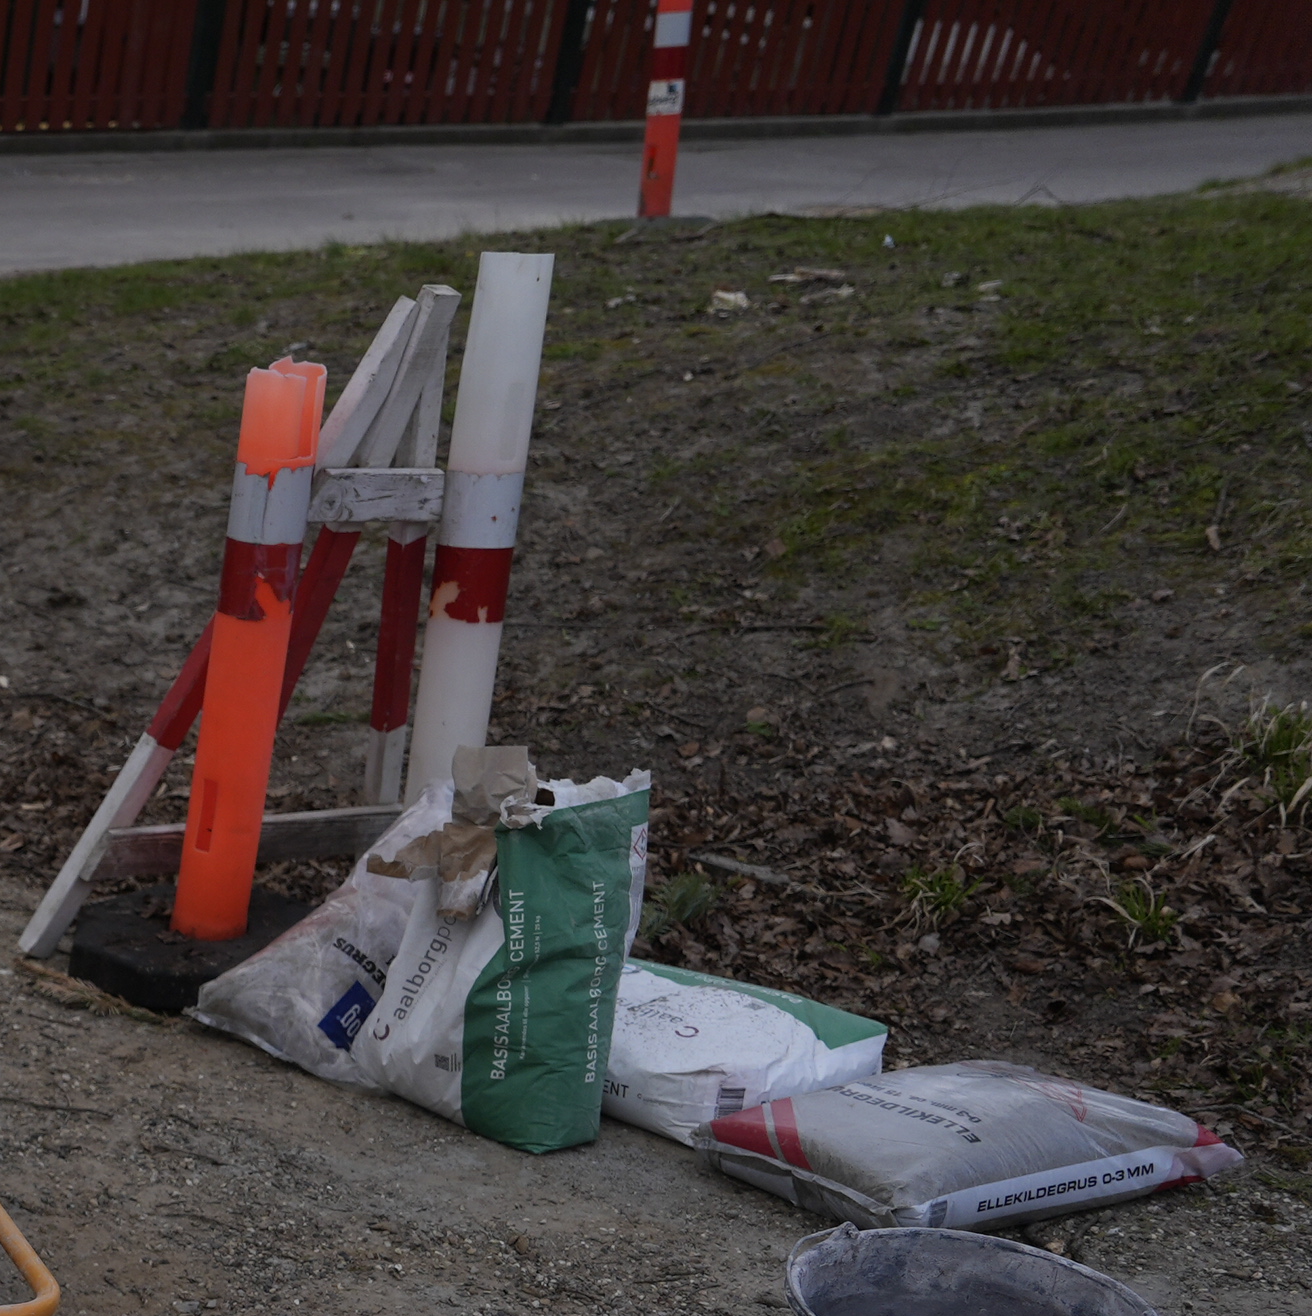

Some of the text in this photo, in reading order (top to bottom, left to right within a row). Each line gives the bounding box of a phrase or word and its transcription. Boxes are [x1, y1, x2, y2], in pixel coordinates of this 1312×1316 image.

[490, 1036, 508, 1080] BASIS
[509, 889, 524, 962] CEMENT
[585, 881, 608, 1083] BASIS AALBORG CEMENT
[977, 1163, 1155, 1212] ELLEKILDEGRUS 0-3 MM
